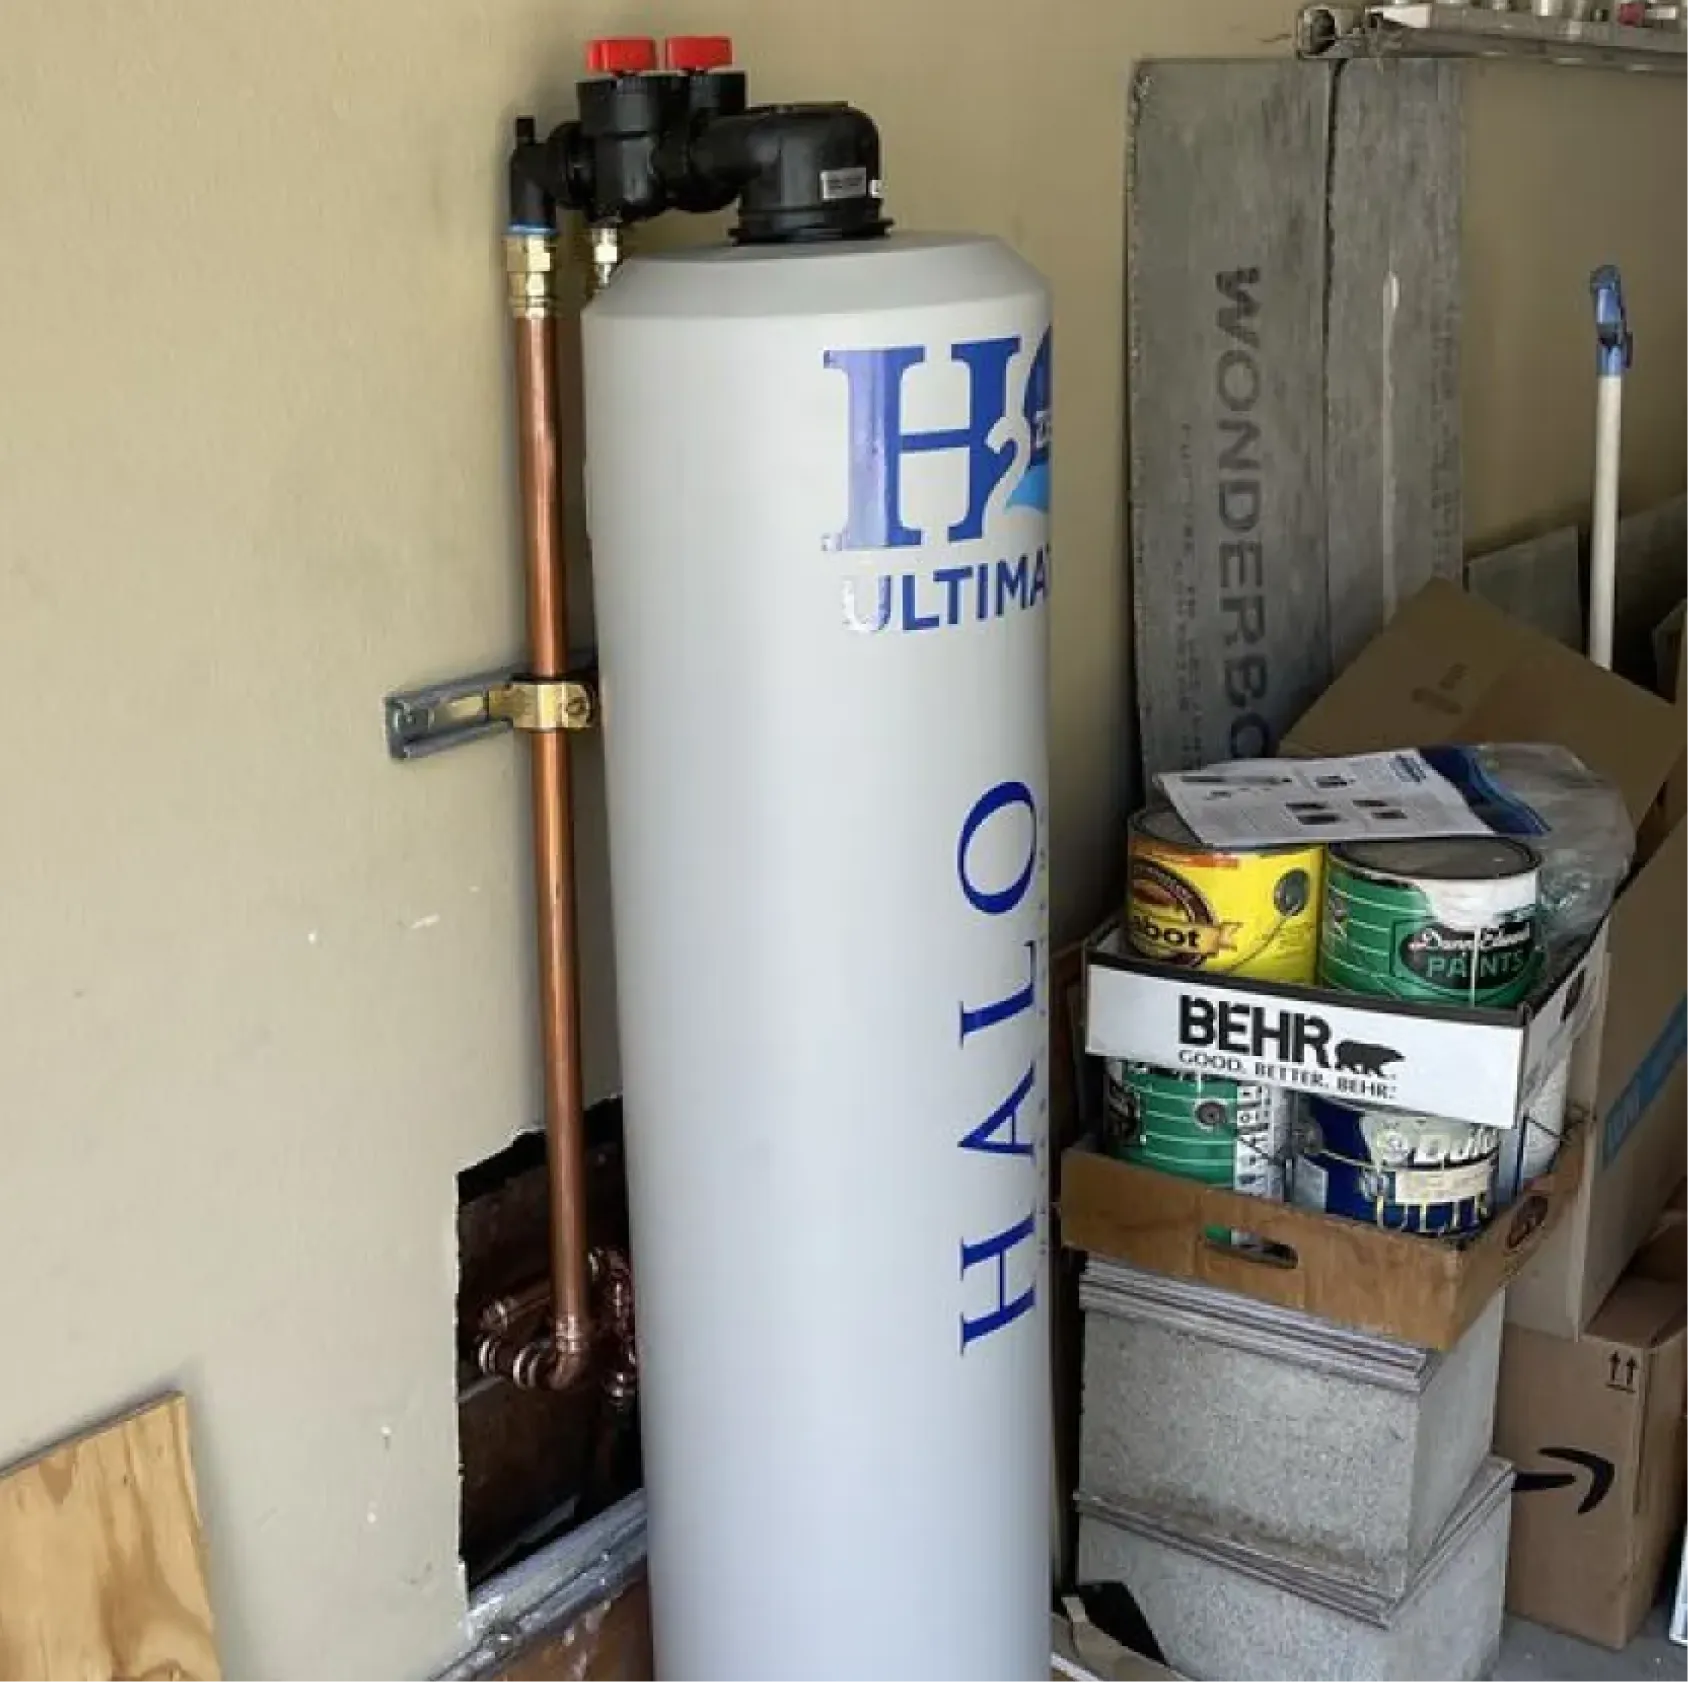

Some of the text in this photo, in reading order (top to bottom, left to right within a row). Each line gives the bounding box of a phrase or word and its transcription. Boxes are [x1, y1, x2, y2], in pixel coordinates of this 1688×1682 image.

[843, 543, 1051, 632] ULTIMA
[1426, 950, 1525, 978] PANTS
[957, 781, 1037, 1356] HALO
[1180, 995, 1331, 1069] BEHR
